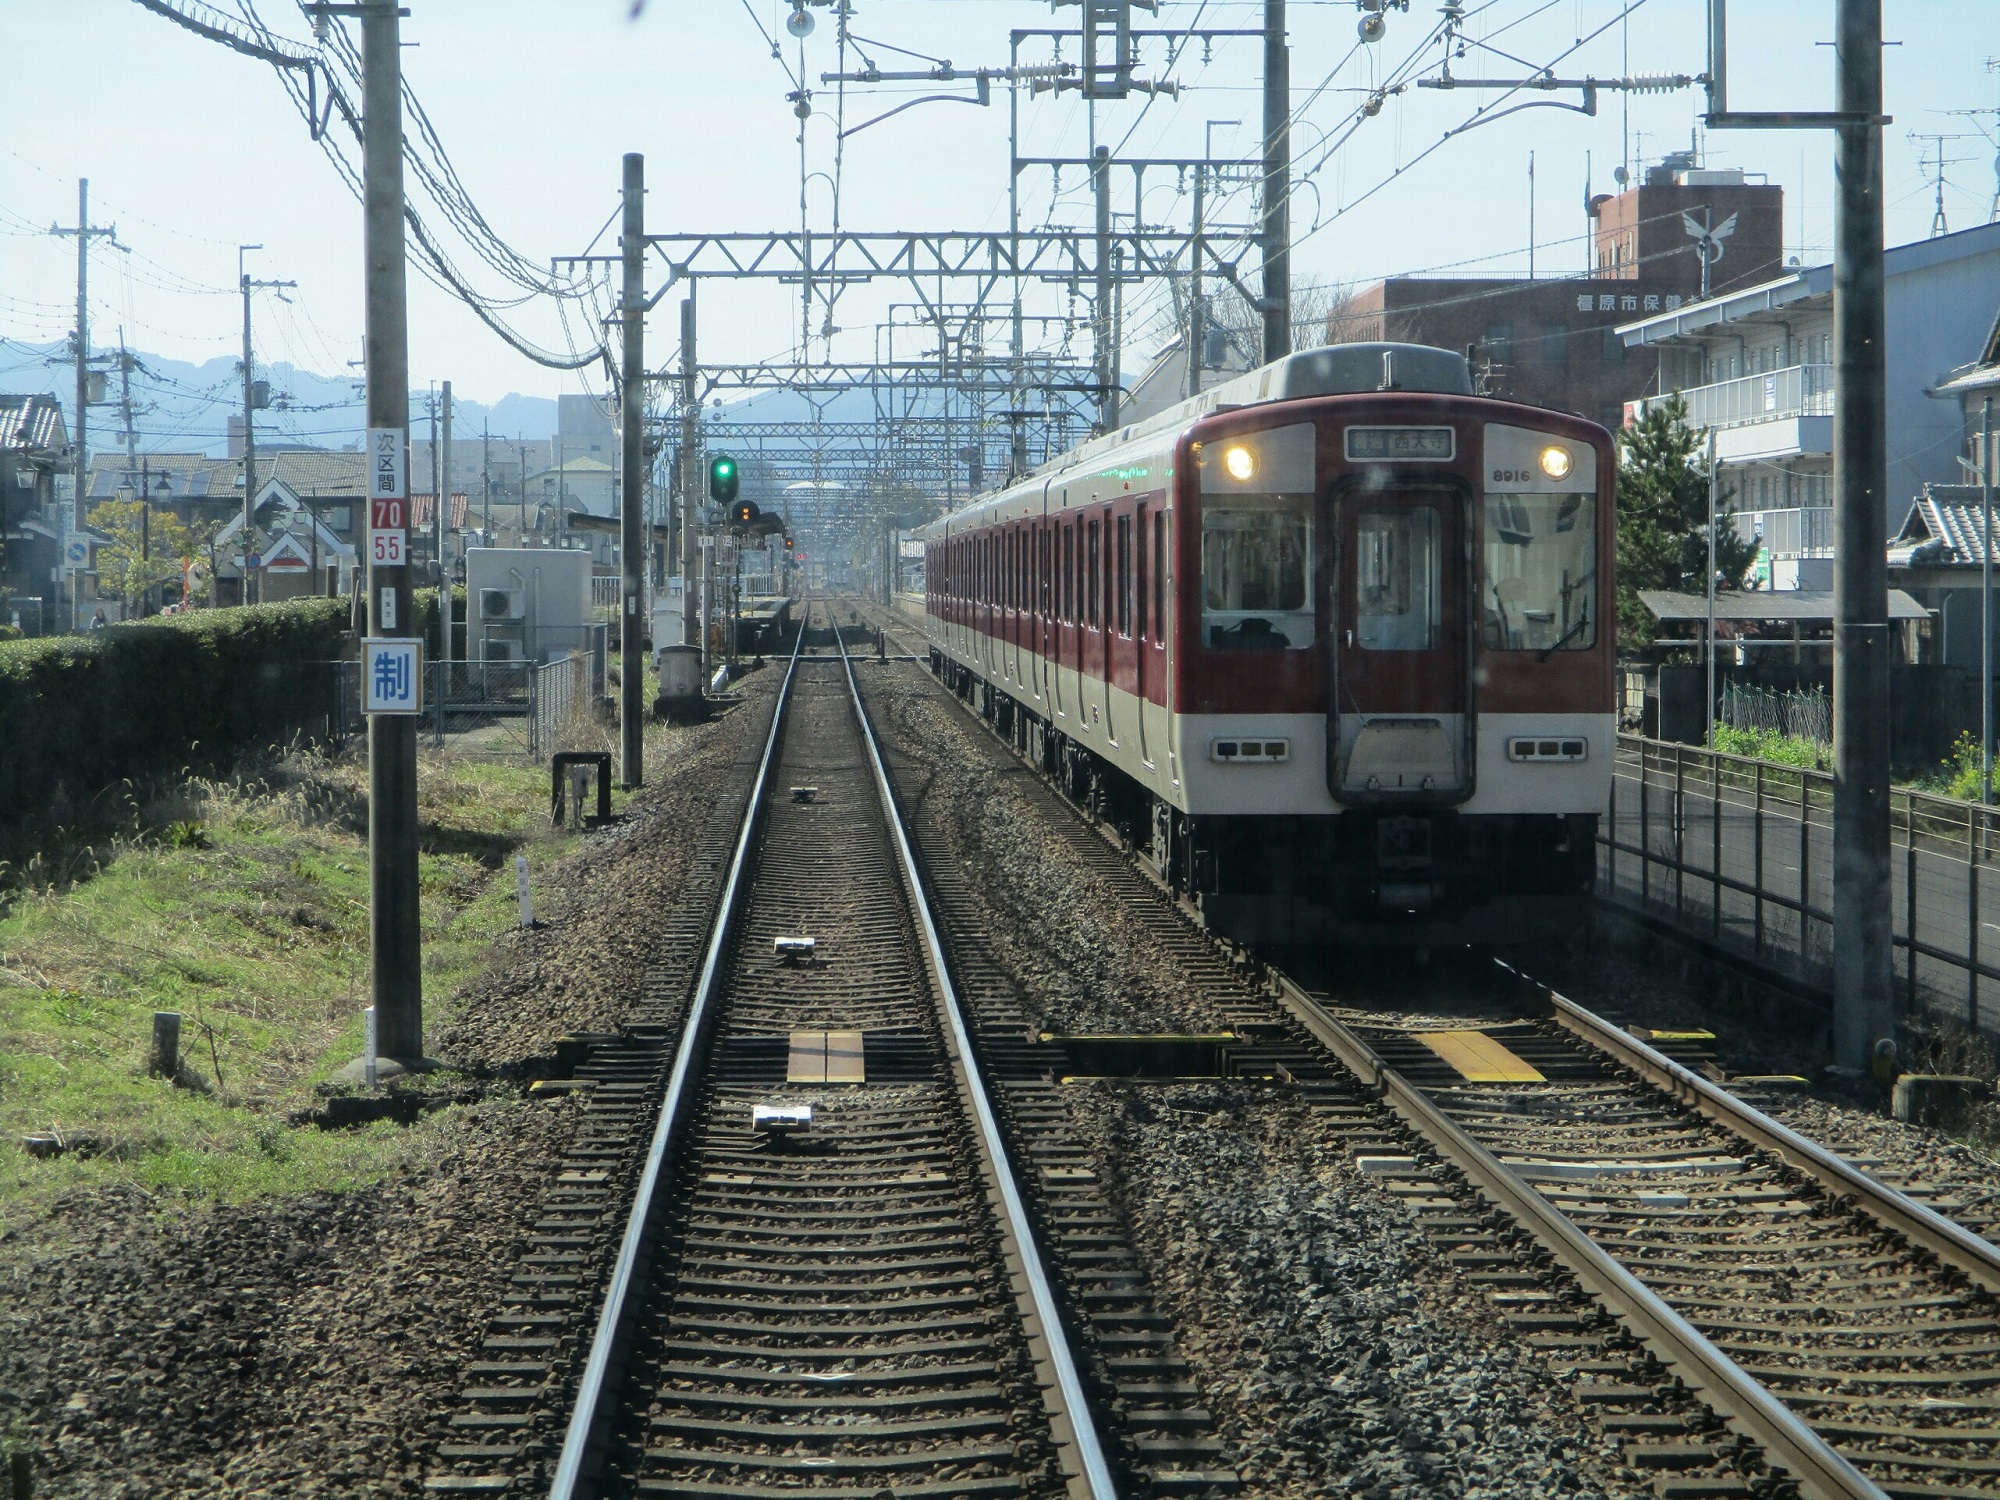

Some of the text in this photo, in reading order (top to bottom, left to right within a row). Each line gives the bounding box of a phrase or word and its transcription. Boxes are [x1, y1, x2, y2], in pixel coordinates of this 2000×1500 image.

[377, 433, 395, 492] 次区間
[1493, 470, 1530, 482] 8916
[376, 501, 401, 527] 70
[375, 536, 399, 560] 55
[375, 652, 409, 701] 制
